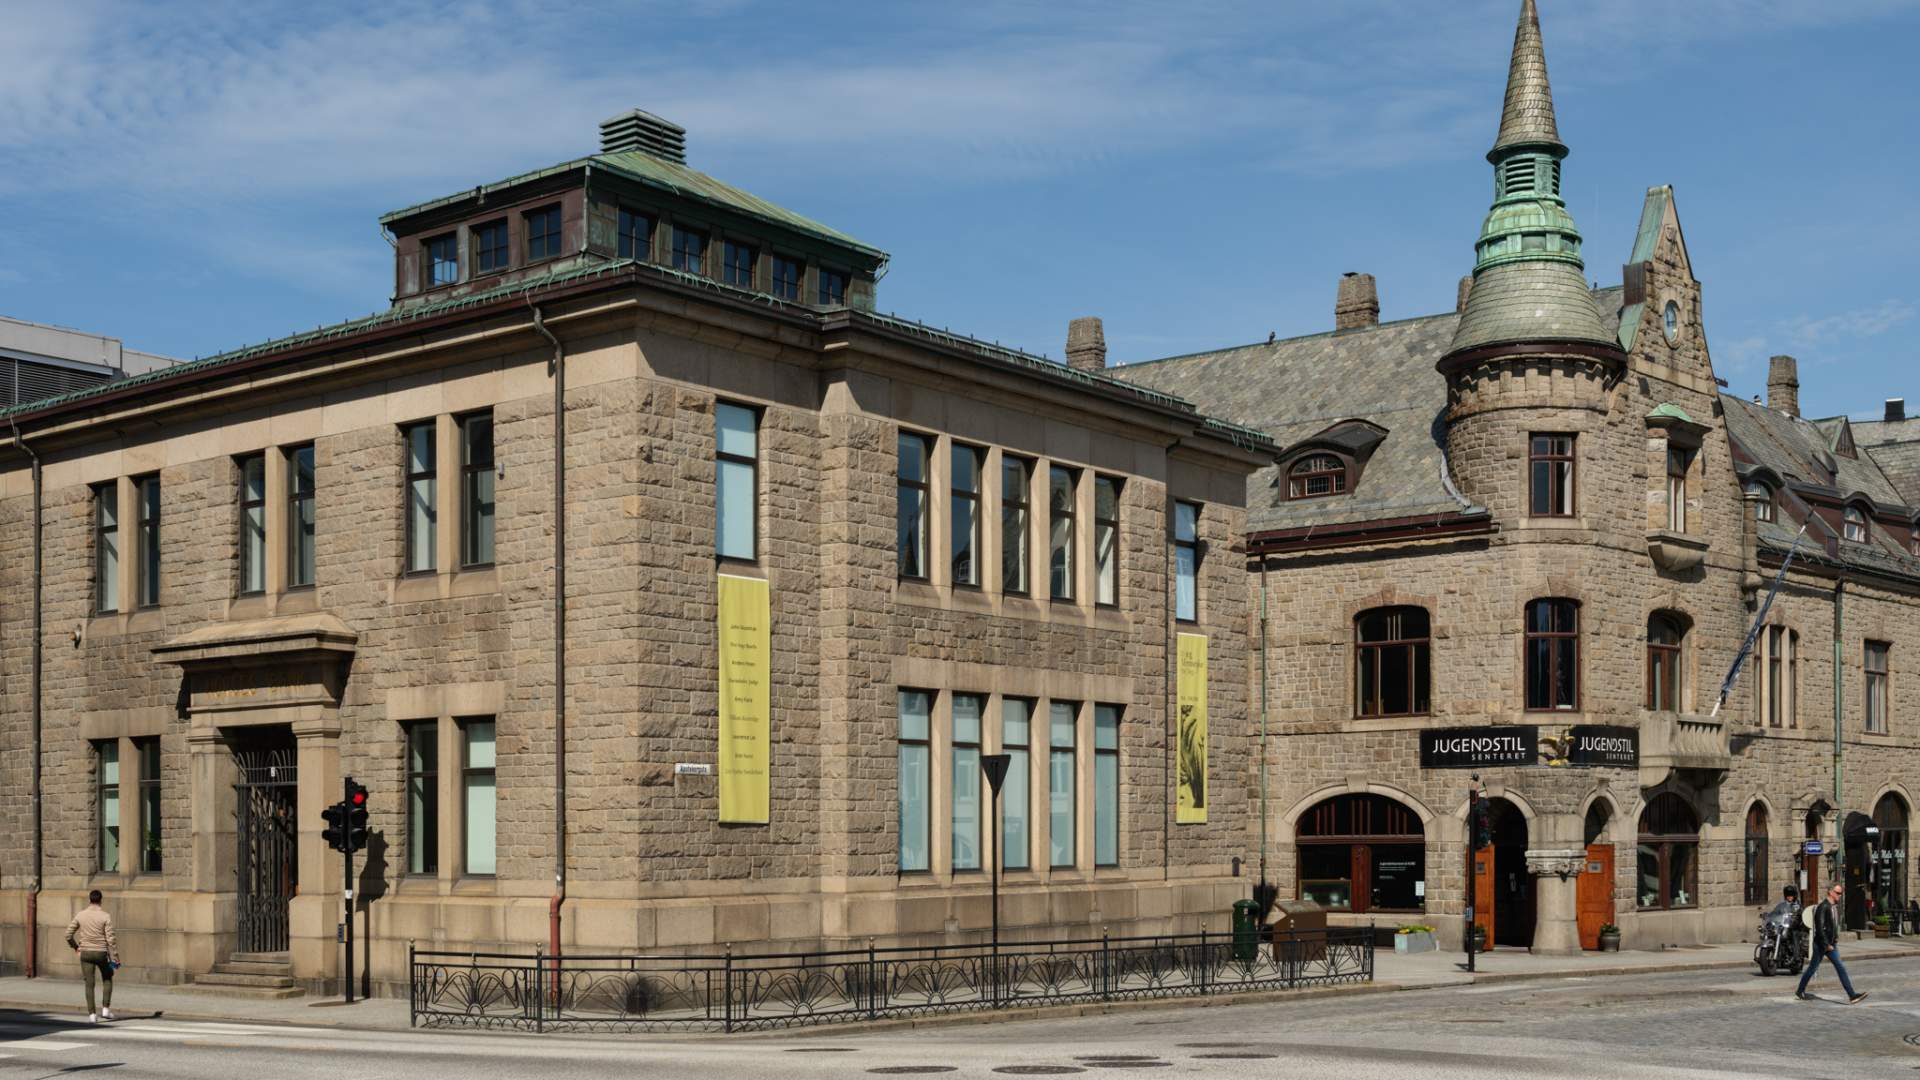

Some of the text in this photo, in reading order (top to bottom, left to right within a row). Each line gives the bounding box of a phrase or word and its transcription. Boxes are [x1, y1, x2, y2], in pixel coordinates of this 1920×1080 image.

[1432, 737, 1526, 753] JUGENDSTIL
[1579, 736, 1634, 753] JUGENDSTIL
[1472, 752, 1526, 761] SENTERET
[1606, 753, 1634, 761] SENTERET
